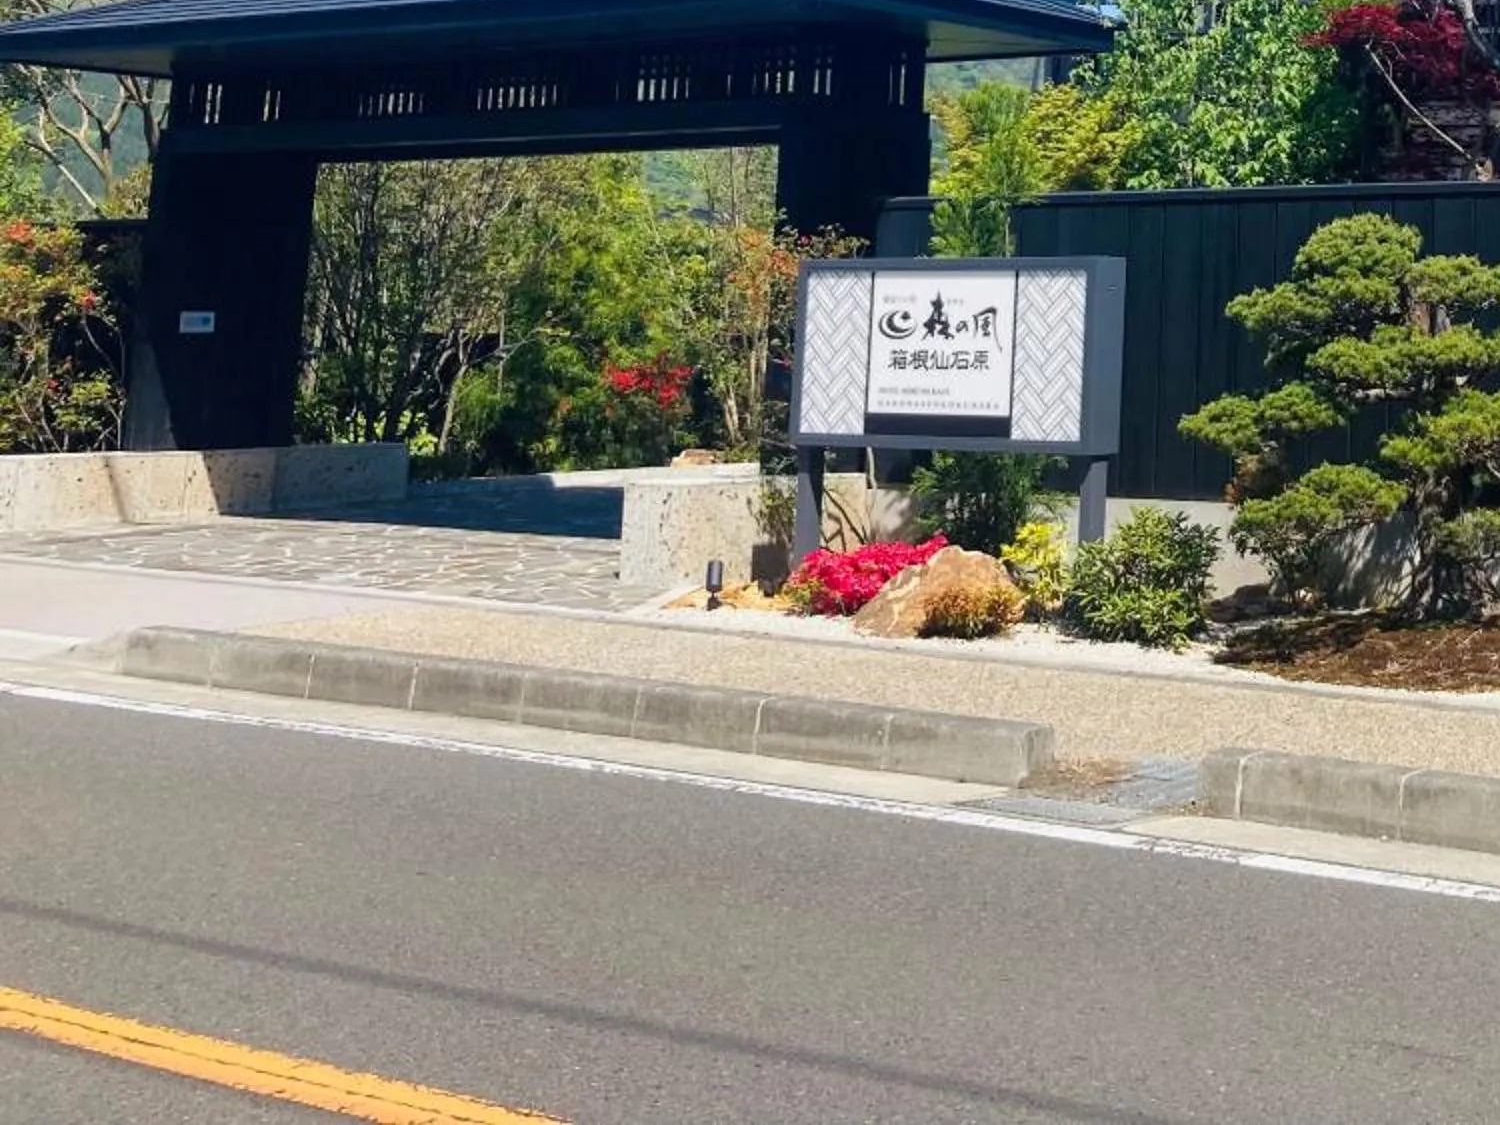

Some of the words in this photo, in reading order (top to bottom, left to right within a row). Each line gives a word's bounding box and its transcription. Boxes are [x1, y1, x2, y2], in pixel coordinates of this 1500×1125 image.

[887, 349, 990, 371] 箱根仙石原
